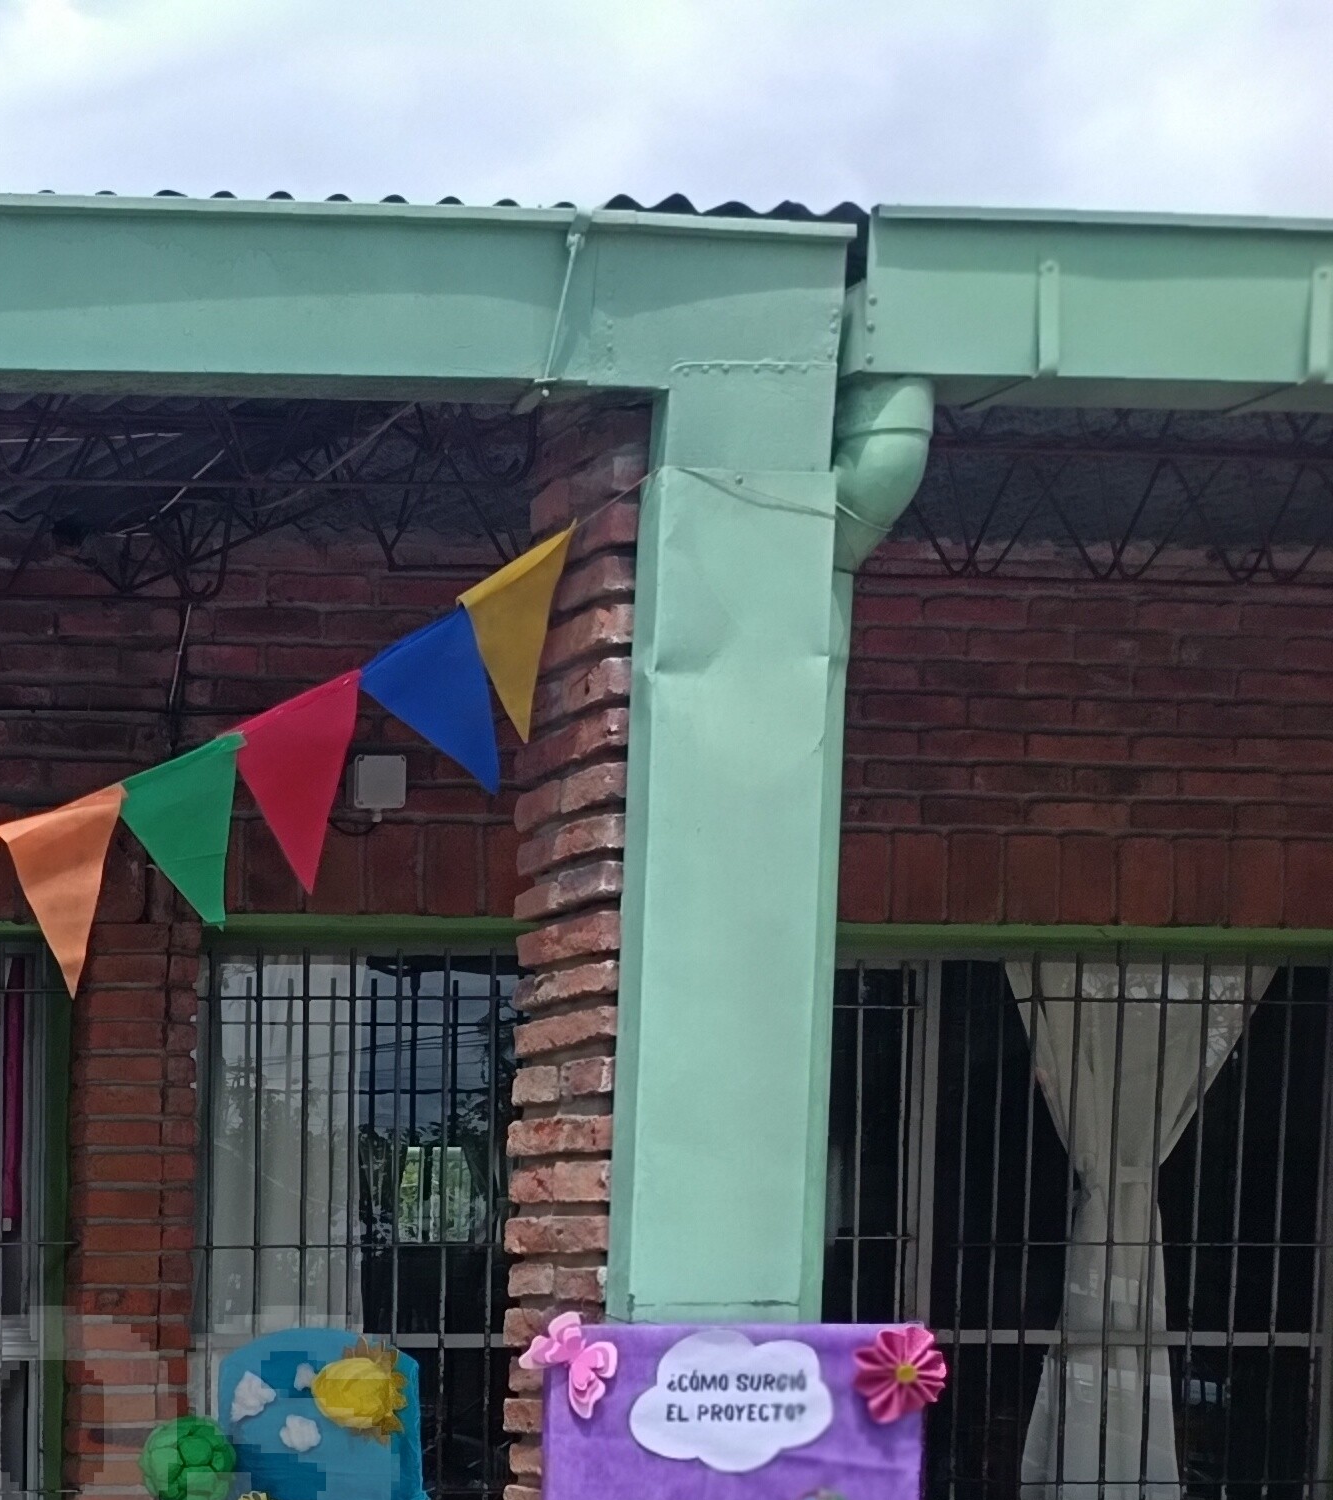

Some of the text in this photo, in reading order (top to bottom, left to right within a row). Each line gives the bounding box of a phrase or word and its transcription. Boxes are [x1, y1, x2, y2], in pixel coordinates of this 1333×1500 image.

[666, 1369, 807, 1392] ¿CÓMO SURGIÓ
[666, 1403, 807, 1422] EL PROYECTO?
